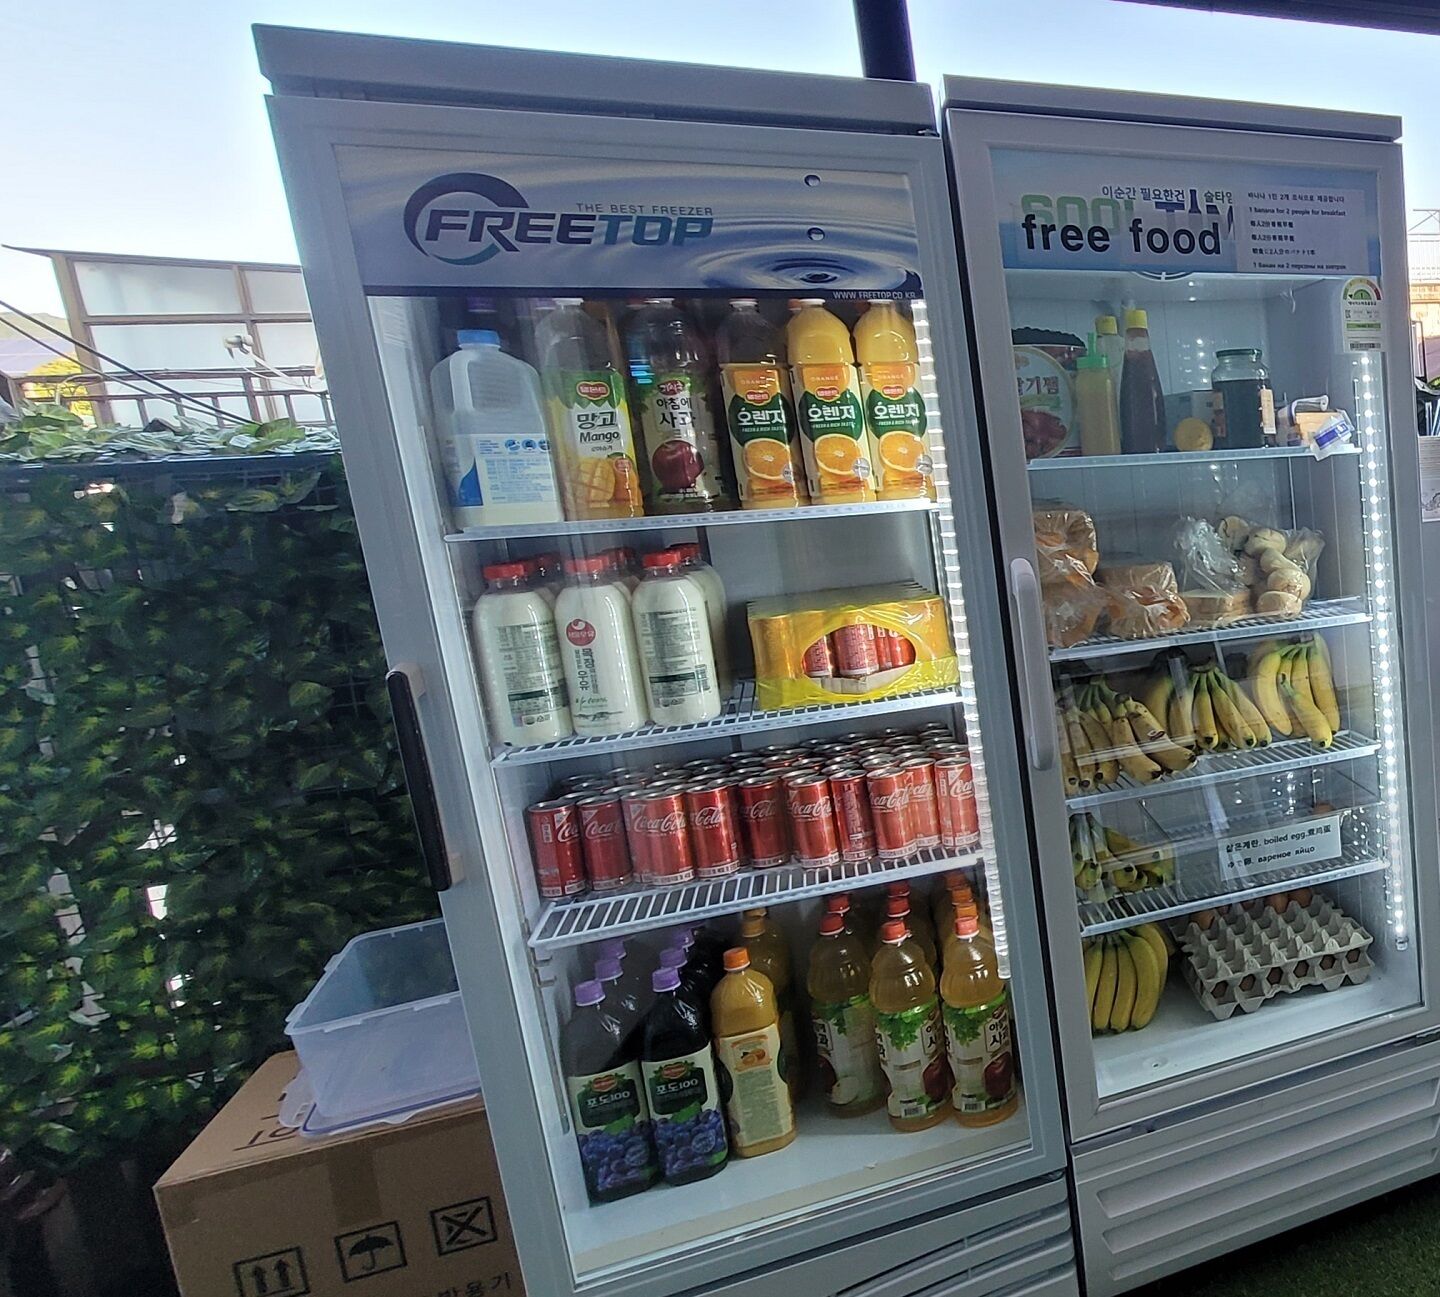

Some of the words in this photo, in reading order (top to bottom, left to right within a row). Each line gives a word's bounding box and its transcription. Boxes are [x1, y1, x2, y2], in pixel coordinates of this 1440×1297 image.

[1102, 185, 1136, 200] 이순간
[1140, 187, 1185, 203] 필요한건
[576, 202, 604, 213] THE
[610, 203, 644, 215] BEST
[652, 205, 714, 217] FREEZER
[1291, 209, 1310, 217] people
[1321, 209, 1346, 217] breakfast
[424, 208, 714, 253] FREETOP
[1021, 213, 1111, 253] free
[1128, 217, 1222, 256] food
[737, 407, 786, 426] 오렌지
[807, 404, 856, 422] 오렌지
[873, 401, 920, 420] 오렌지
[576, 411, 617, 430] 망고
[579, 431, 621, 444] Mango
[1264, 834, 1288, 846] boiled
[1257, 850, 1292, 863] вареное
[1294, 845, 1316, 857] яйцо
[655, 1078, 700, 1096] 포도100
[586, 1090, 632, 1109] 포도100
